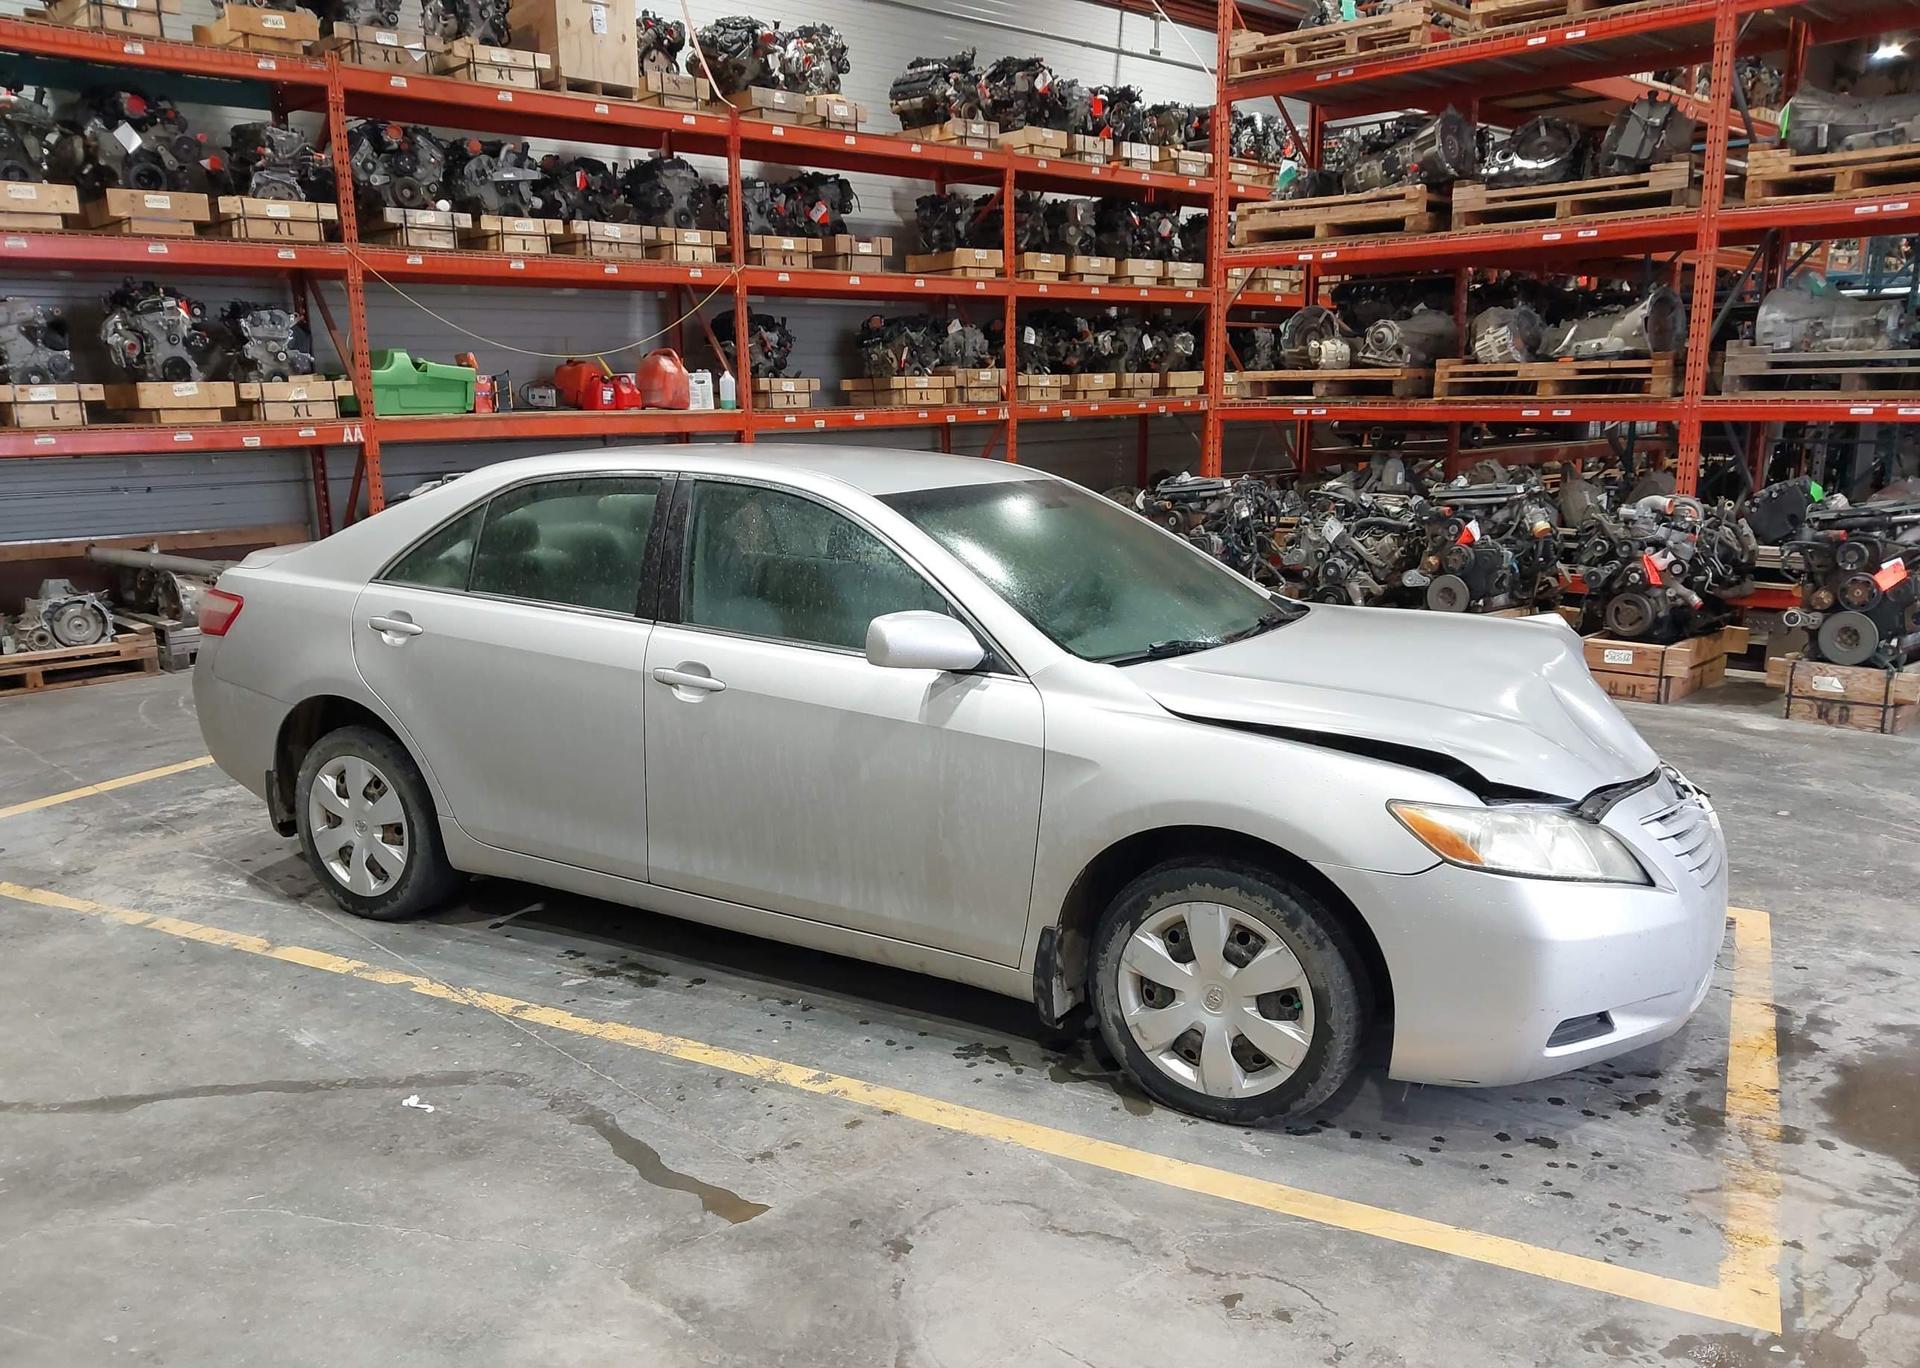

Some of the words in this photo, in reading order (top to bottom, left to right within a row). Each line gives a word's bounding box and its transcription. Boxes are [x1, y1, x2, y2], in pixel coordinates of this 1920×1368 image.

[274, 222, 295, 236] XL
[50, 406, 60, 420] L
[293, 405, 313, 418] XL
[998, 408, 1009, 420] AA
[343, 427, 365, 443] AA
